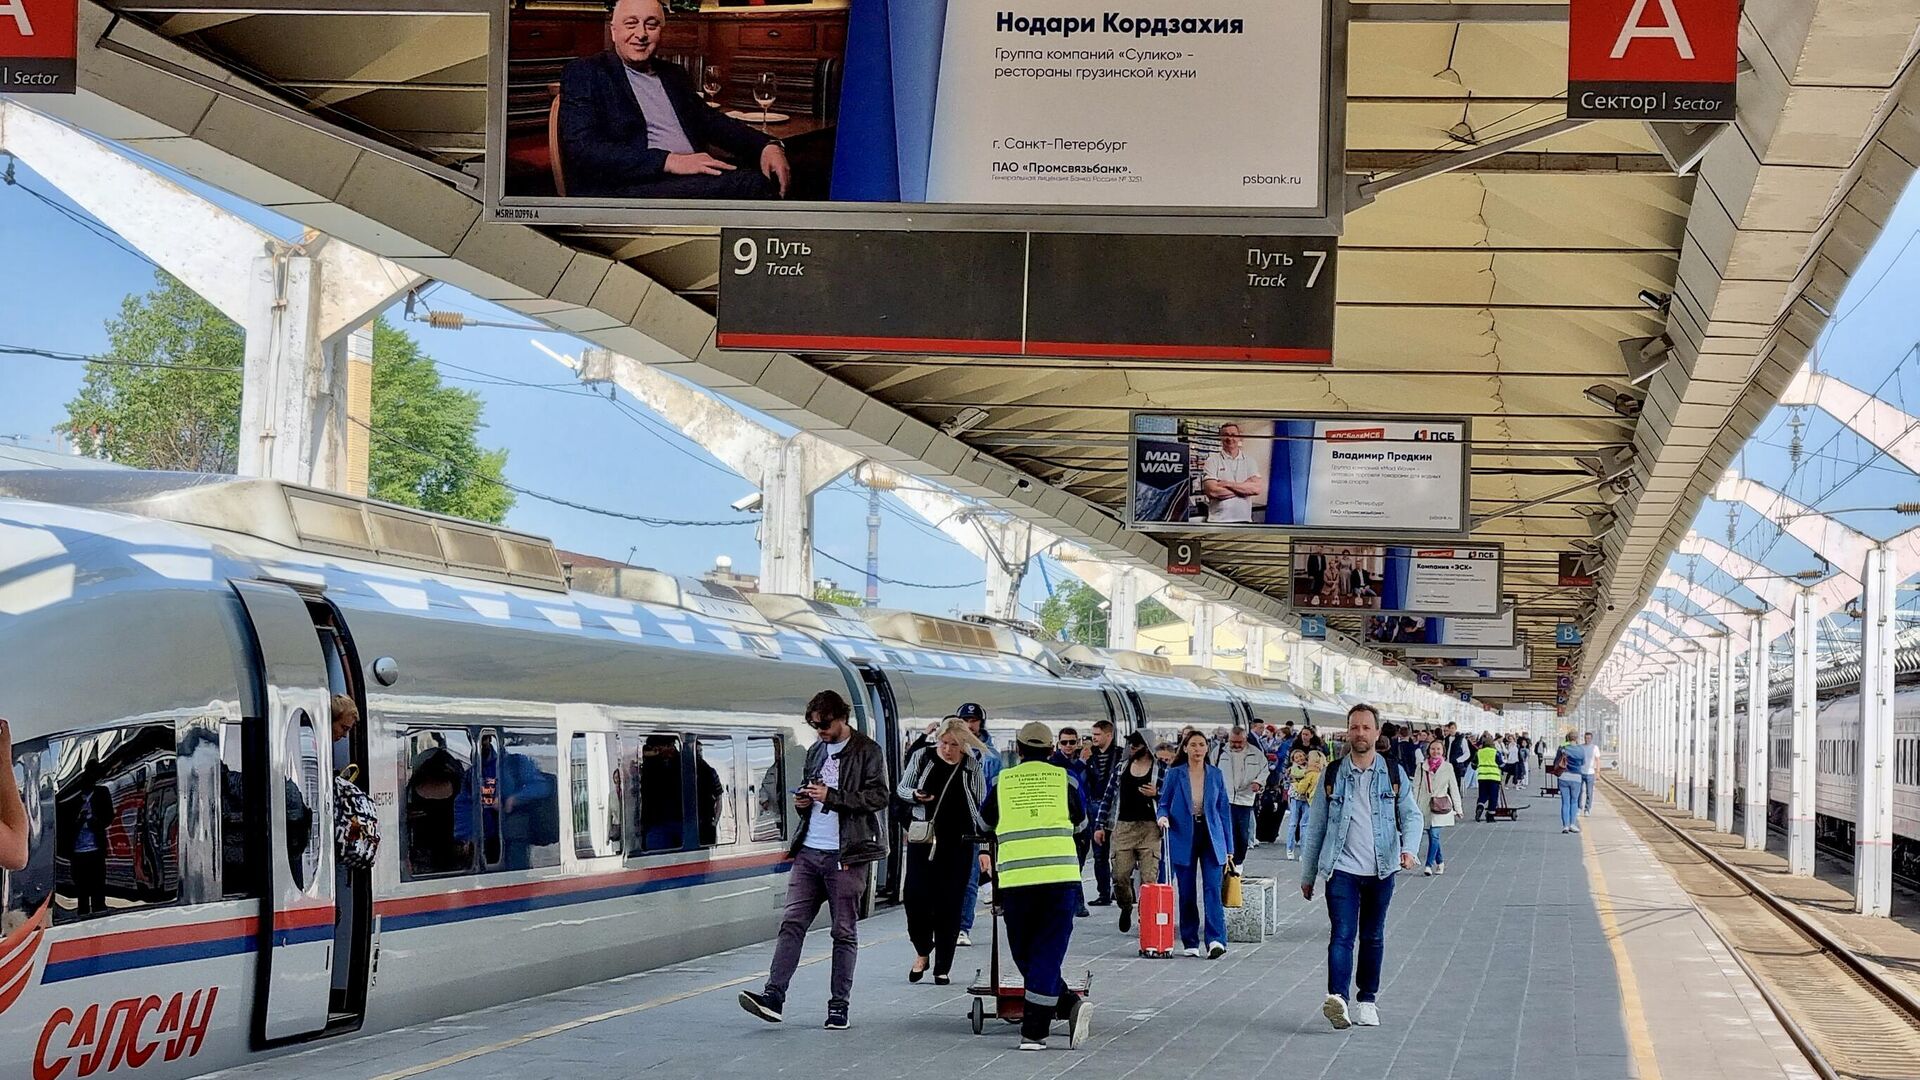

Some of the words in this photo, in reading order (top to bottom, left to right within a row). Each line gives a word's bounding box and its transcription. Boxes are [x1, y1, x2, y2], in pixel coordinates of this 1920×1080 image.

[996, 12, 1096, 37] Нодари
[1103, 12, 1244, 38] Кордзахия
[994, 48, 1043, 61] Группа
[1046, 48, 1114, 60] компаний
[1118, 48, 1182, 62] «Сулико»
[14, 72, 59, 84] Sector
[994, 67, 1072, 79] рестораны
[1076, 66, 1154, 80] грузинской
[1157, 68, 1196, 80] кухни
[1580, 92, 1656, 114] Сектор
[1673, 96, 1722, 110] Sector
[992, 140, 1000, 150] г.
[1004, 137, 1128, 153] Санкт-Петербург
[992, 162, 1020, 172] ПАО
[1022, 162, 1132, 176] «Промсвязьбанк».
[1242, 174, 1301, 186] psbank.ru
[766, 238, 812, 258] Путь
[734, 238, 758, 275] 9
[1247, 248, 1294, 270] Путь
[766, 262, 804, 276] Track
[1302, 250, 1327, 288] 7
[1248, 274, 1287, 287] Track
[1430, 432, 1456, 442] ПСБ
[1145, 450, 1180, 462] MAD
[1332, 450, 1384, 462] Владимир
[1387, 452, 1432, 462] Предкин
[1140, 462, 1184, 474] WAVE
[1178, 544, 1192, 566] 9
[1564, 626, 1574, 640] B
[33, 986, 218, 1080] САПСАН
